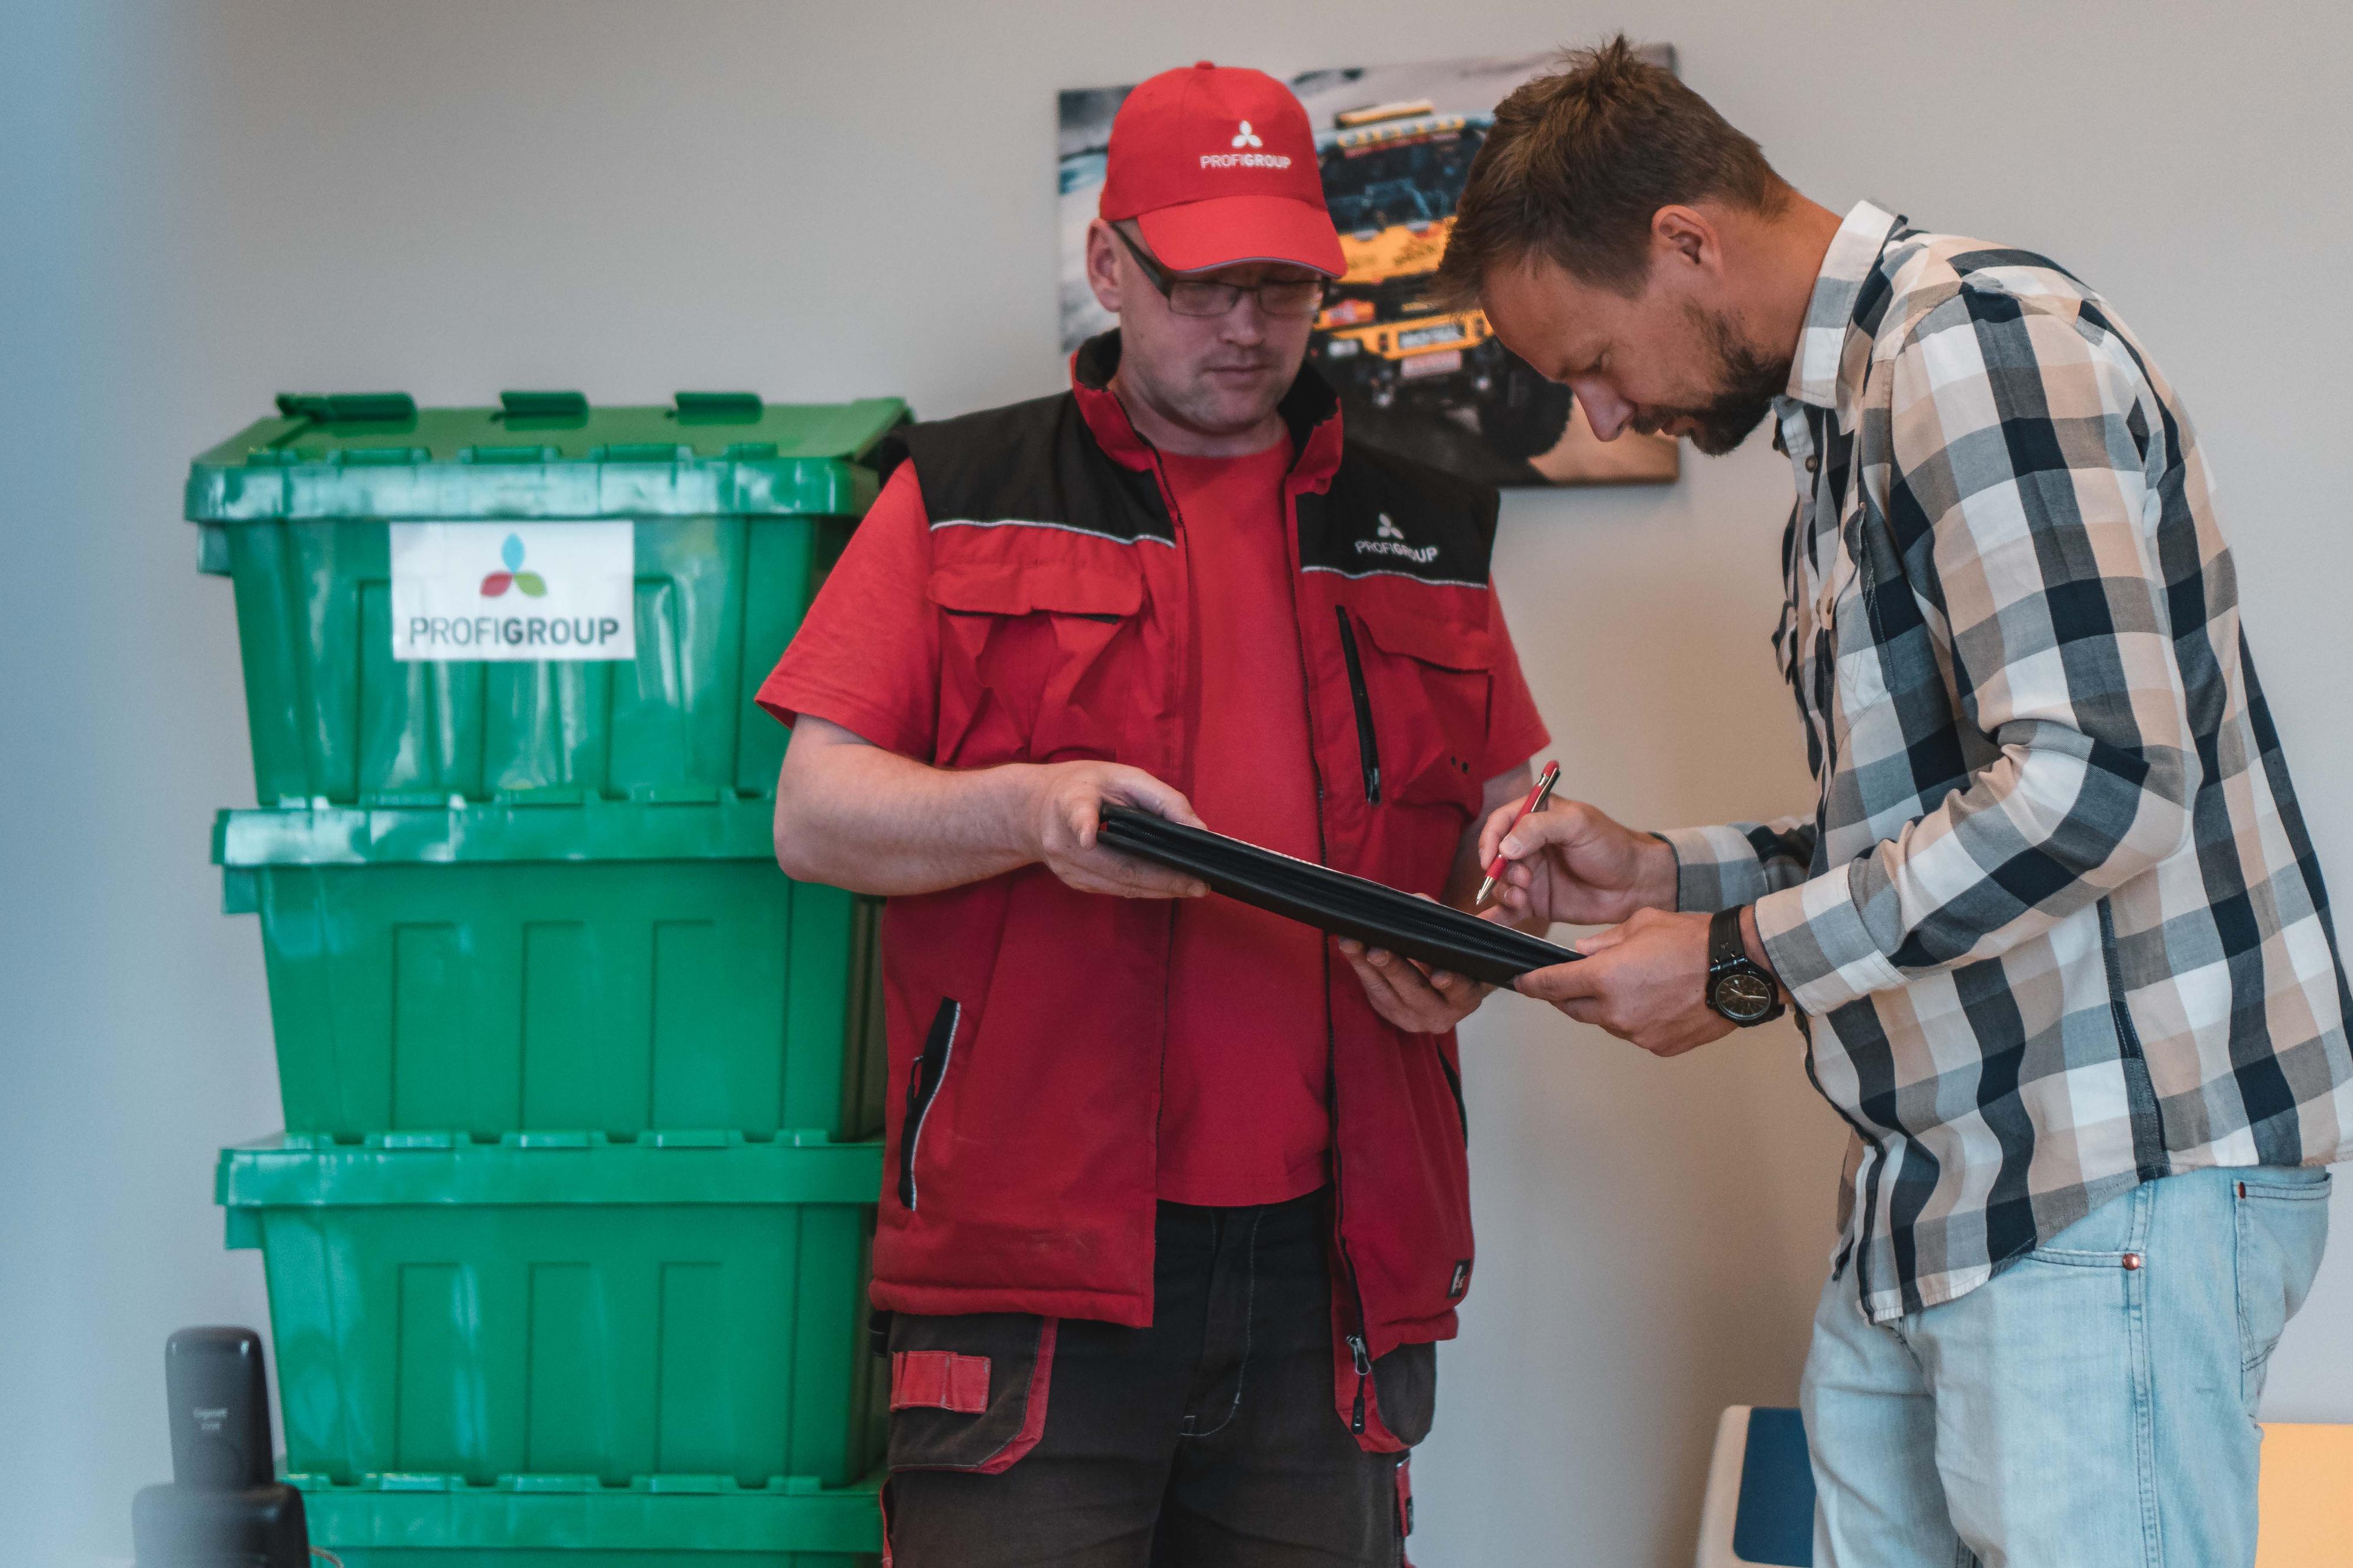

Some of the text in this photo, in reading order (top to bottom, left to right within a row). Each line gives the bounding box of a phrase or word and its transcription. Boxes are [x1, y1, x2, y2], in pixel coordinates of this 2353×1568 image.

[1199, 154, 1292, 169] PROFIGROUP
[1355, 541, 1438, 563] PROFIGROUP
[410, 616, 619, 646] PROFIGROUP
